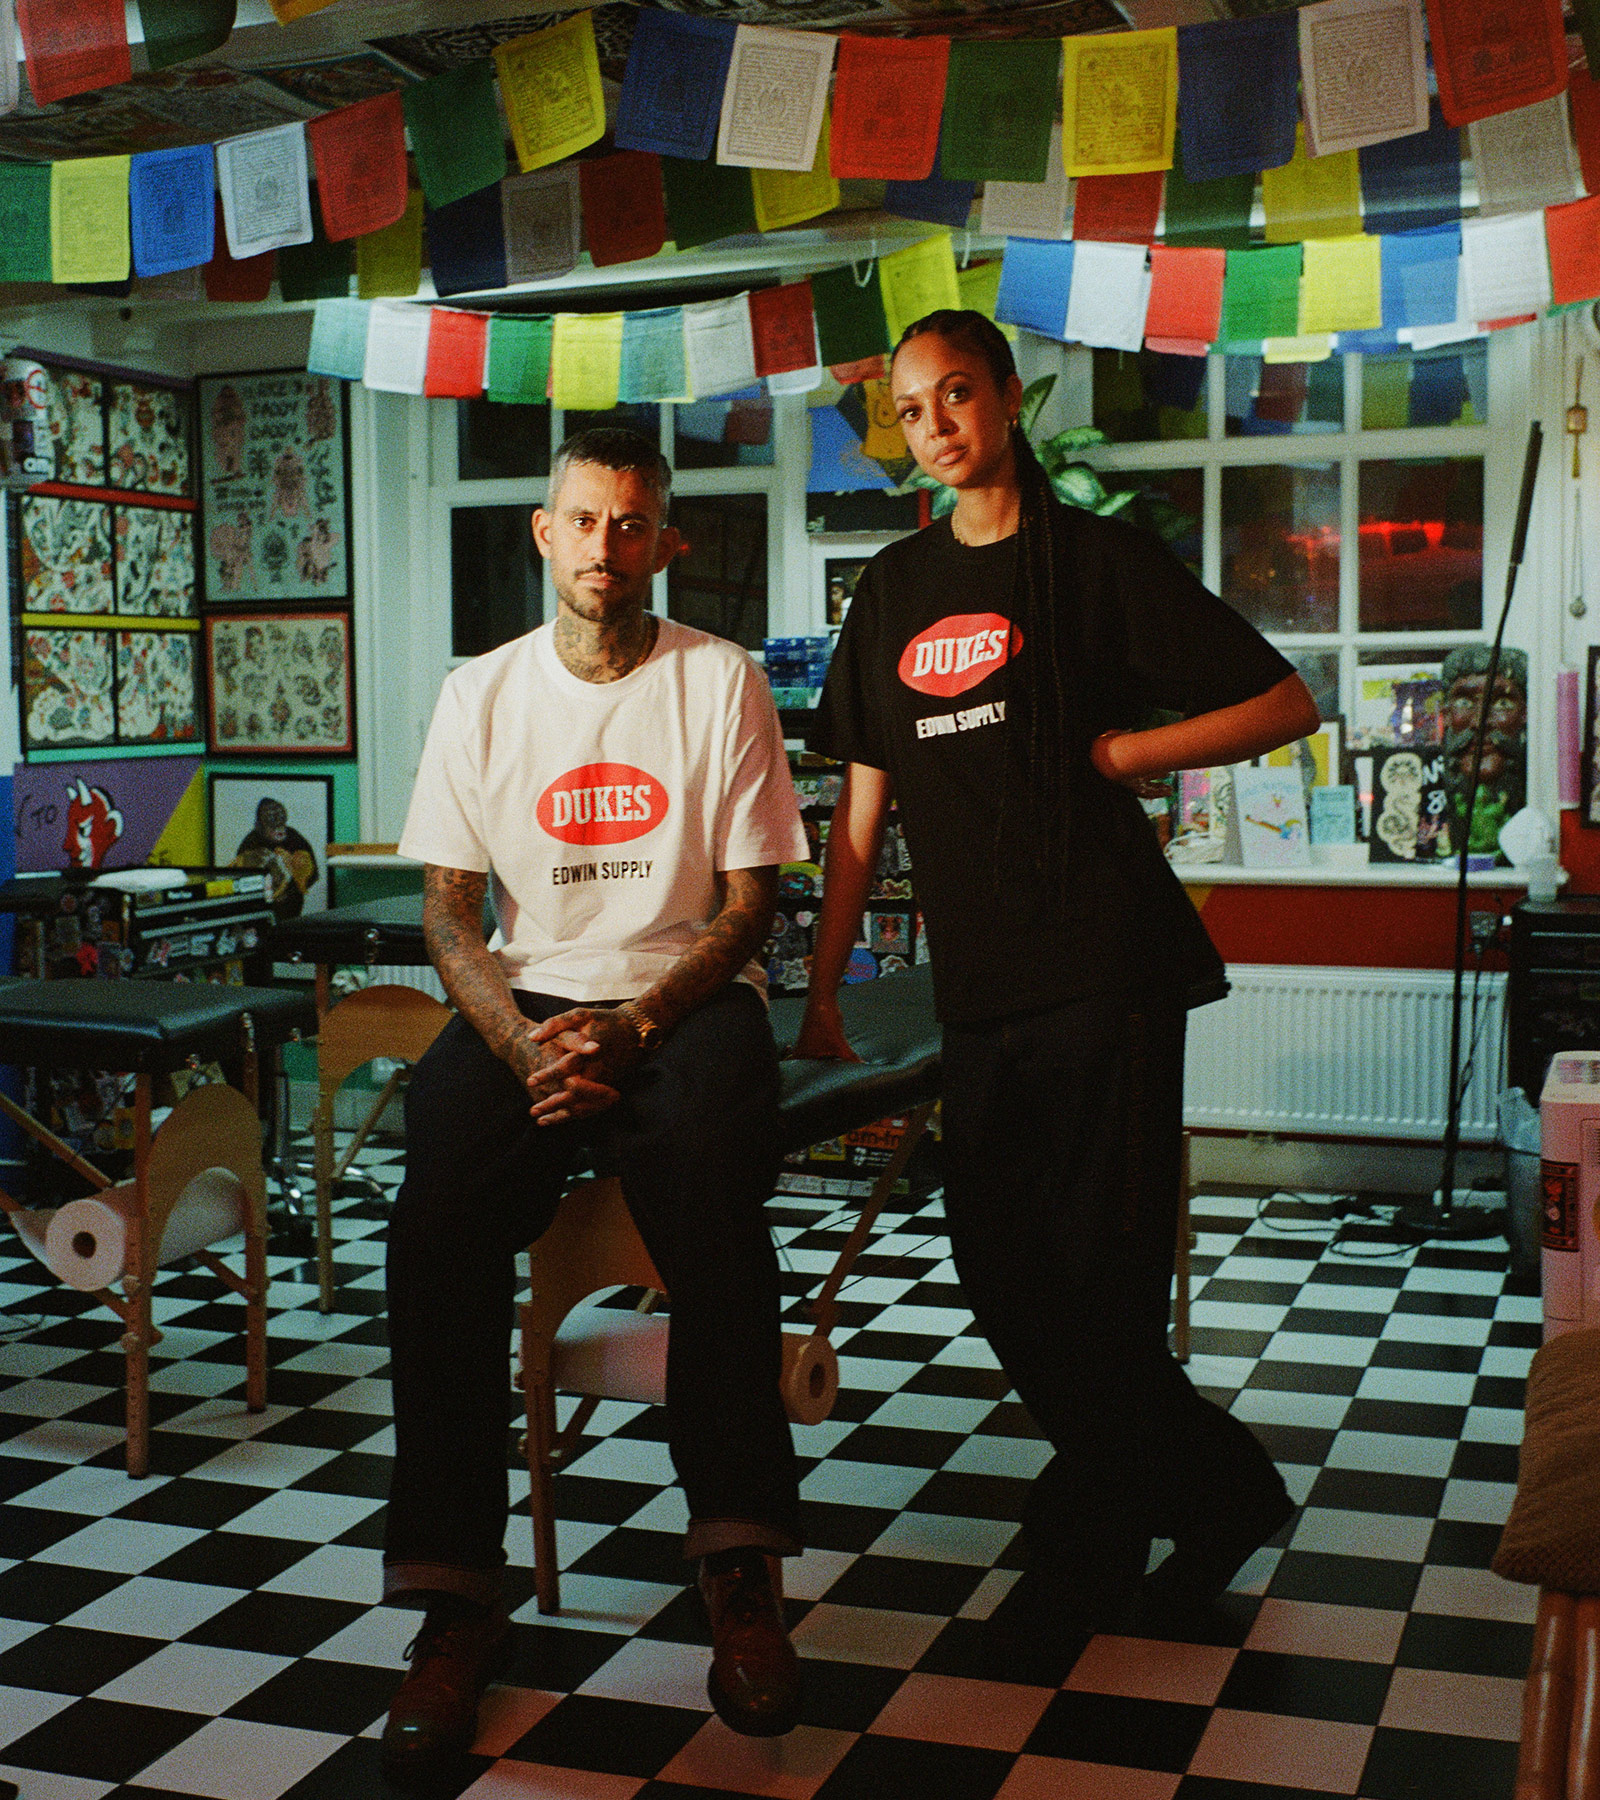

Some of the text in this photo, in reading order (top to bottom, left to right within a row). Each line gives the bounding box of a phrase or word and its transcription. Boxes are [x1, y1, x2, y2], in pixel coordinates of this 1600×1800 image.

[912, 629, 1008, 678] DUKES
[915, 700, 1006, 739] EDWIN SUPPLY
[552, 784, 652, 828] DUKES
[552, 860, 653, 886] EDWIN SUPPLY
